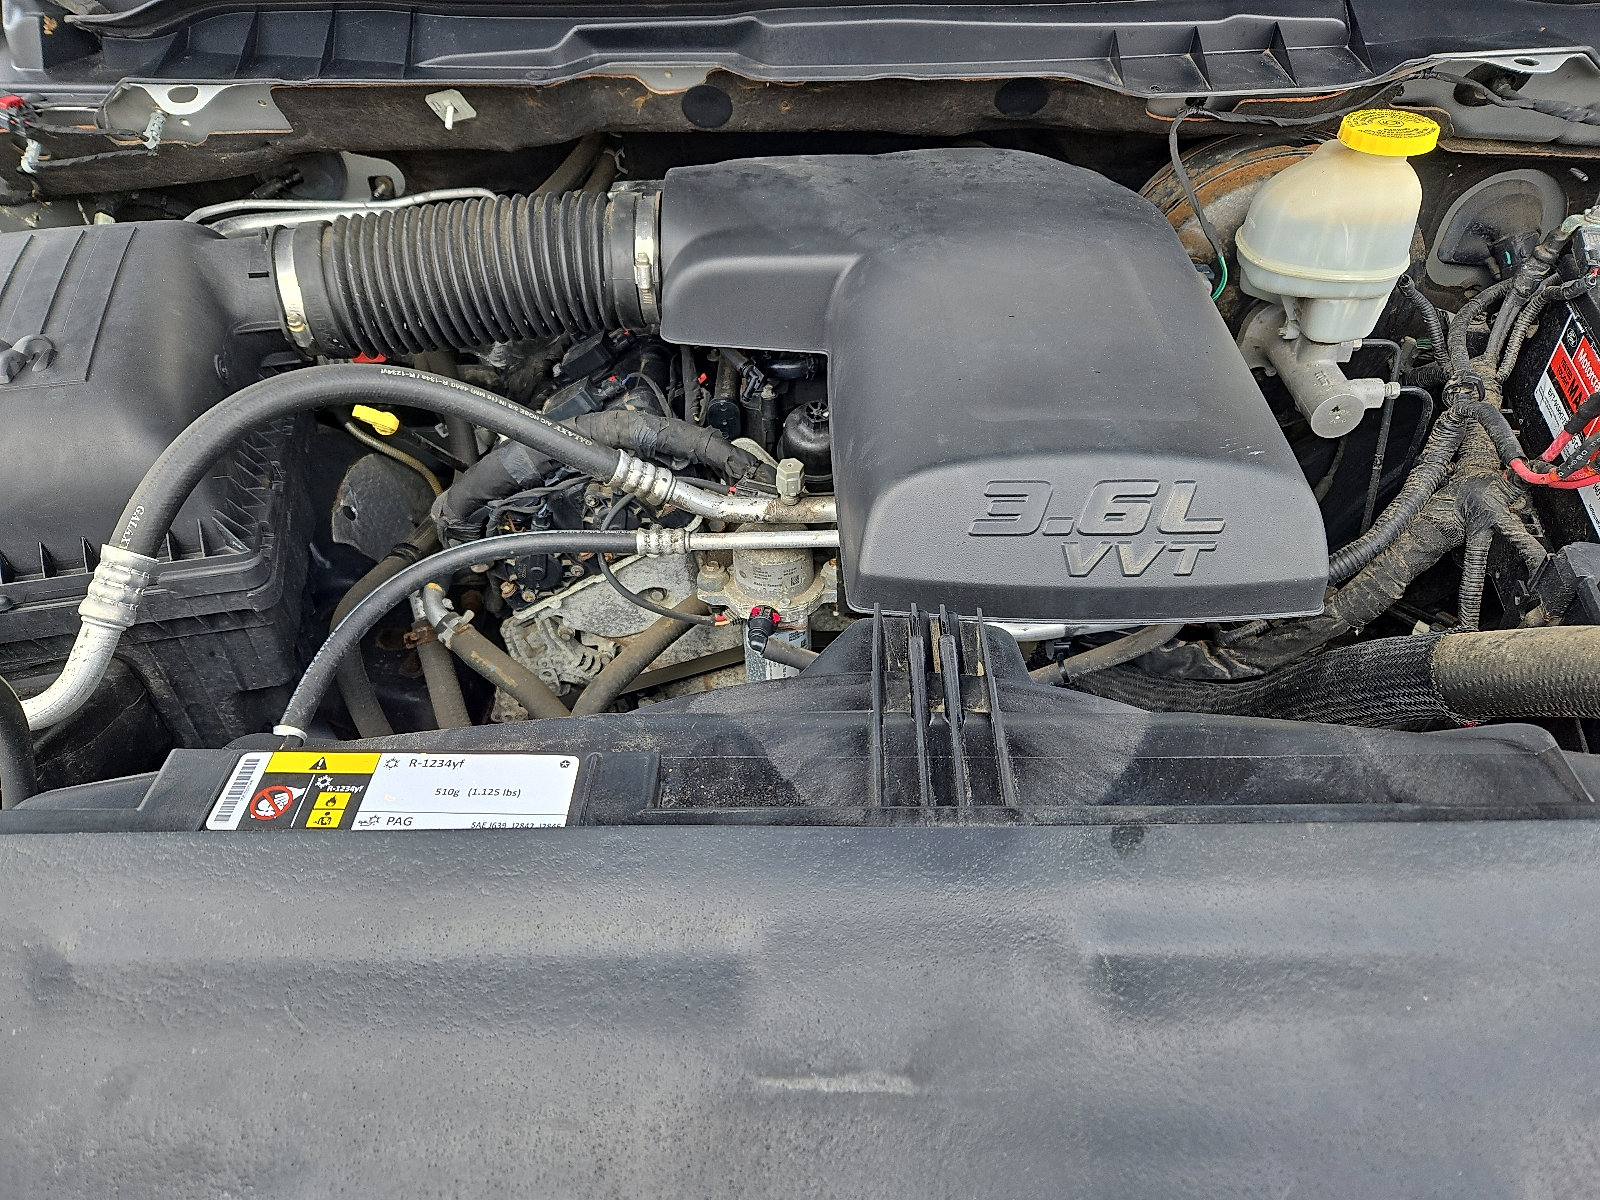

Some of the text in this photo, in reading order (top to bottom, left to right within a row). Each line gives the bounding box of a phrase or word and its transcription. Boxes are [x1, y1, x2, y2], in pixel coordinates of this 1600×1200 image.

[1567, 378, 1583, 411] MA
[554, 425, 593, 446] GALAXY
[968, 478, 1226, 537] 3.6L
[1060, 540, 1218, 578] VVT
[409, 758, 466, 770] R-1234yf
[326, 785, 365, 794] R-1234yf
[434, 788, 521, 799] 510g (1.125 lbs)
[386, 816, 414, 826] PAG
[470, 821, 487, 830] SAE
